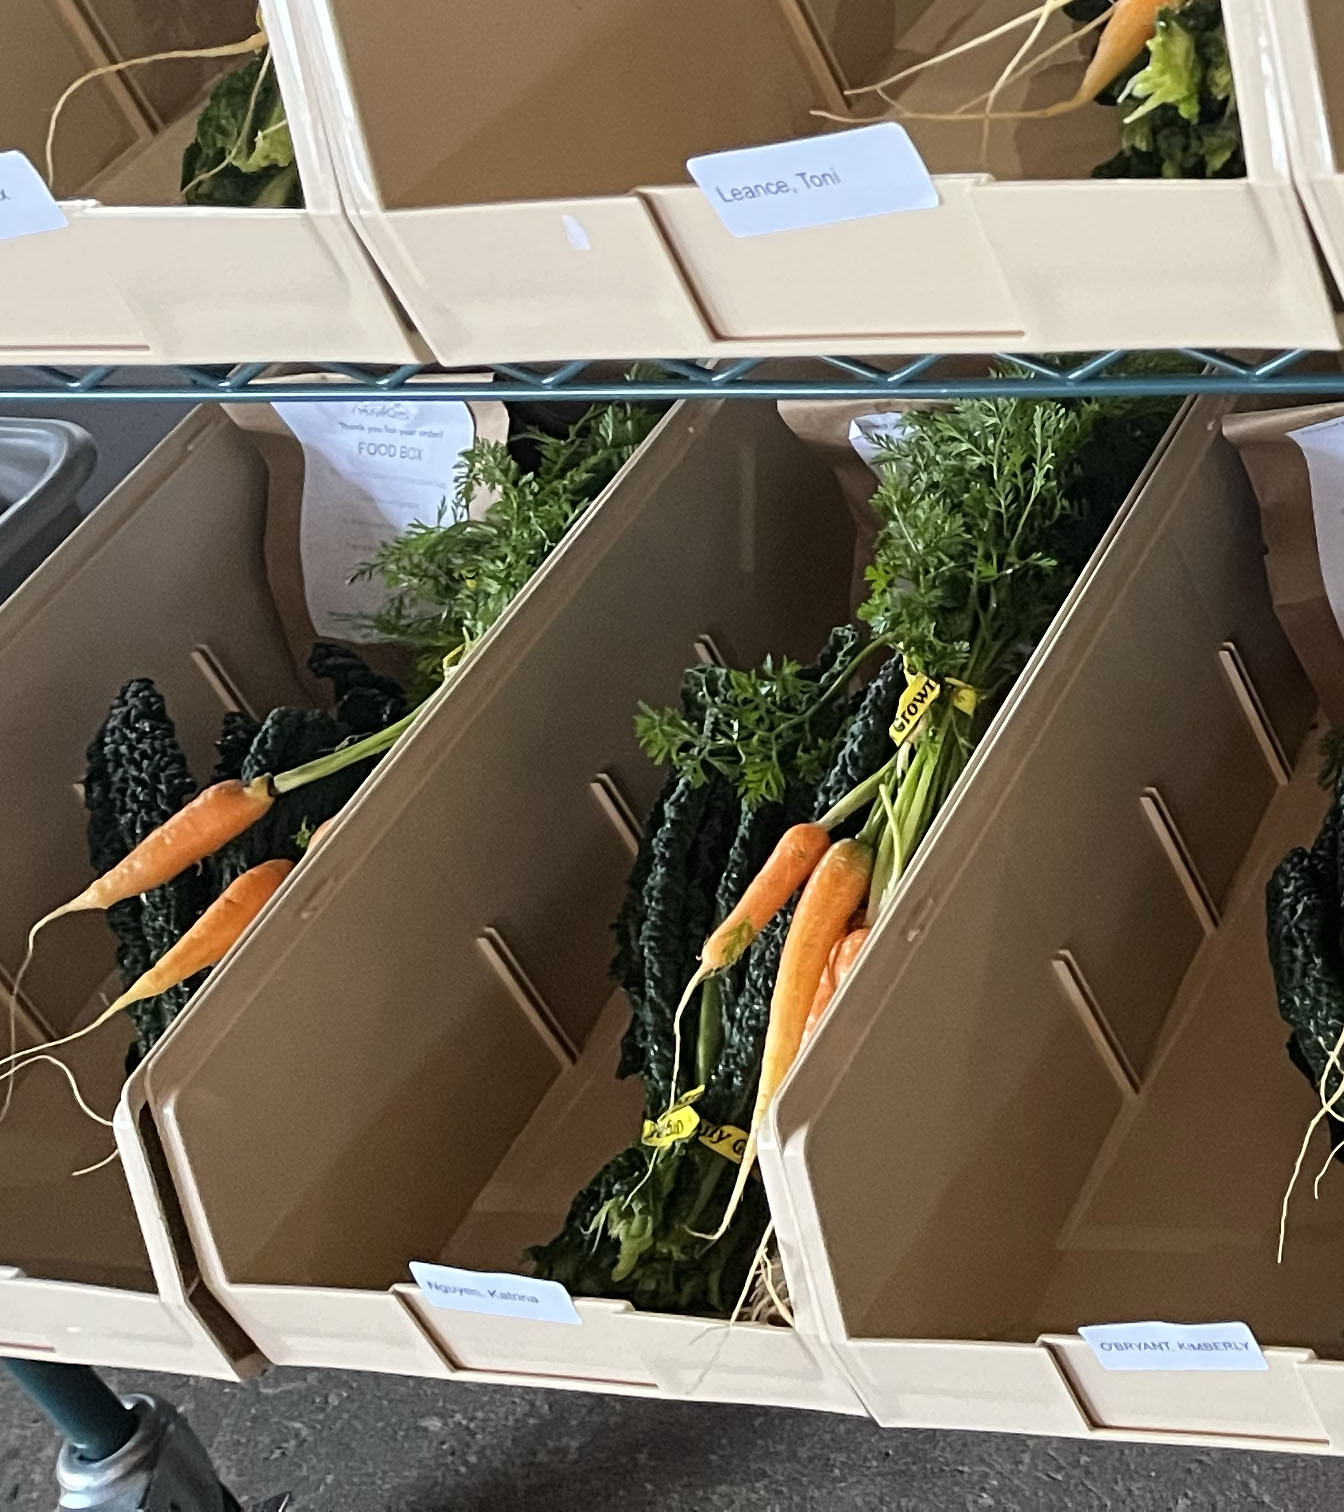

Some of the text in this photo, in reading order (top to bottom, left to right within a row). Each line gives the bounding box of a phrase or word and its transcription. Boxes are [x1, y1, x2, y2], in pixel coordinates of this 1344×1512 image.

[716, 167, 842, 203] Leance, Toni
[358, 441, 424, 460] FOOD BOX
